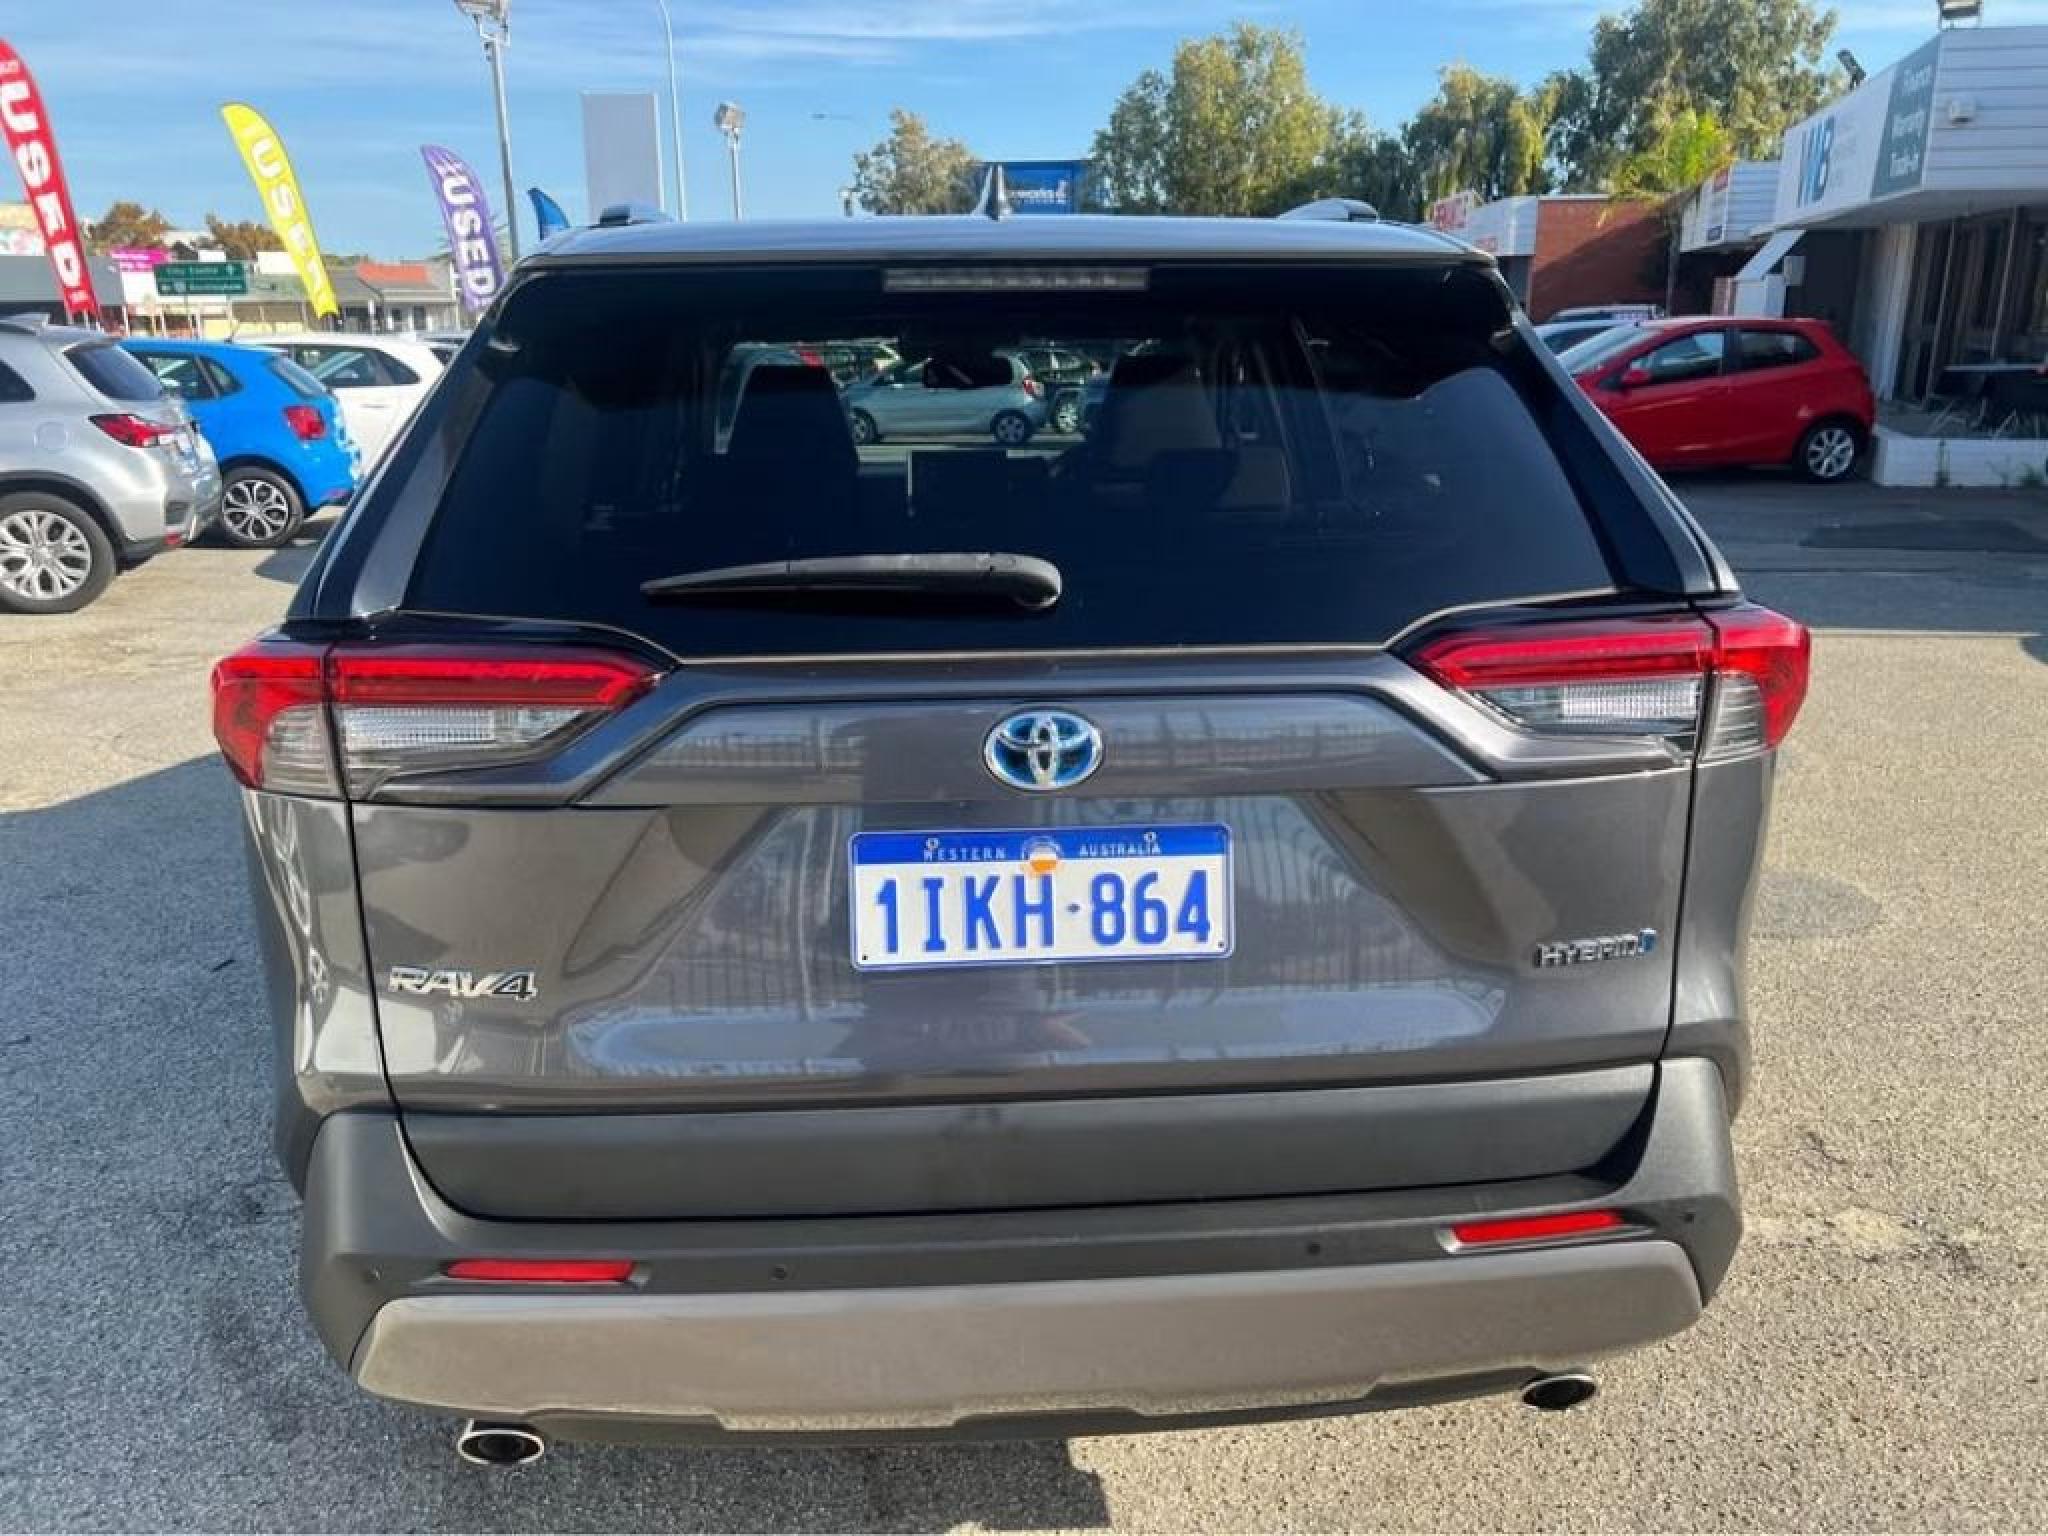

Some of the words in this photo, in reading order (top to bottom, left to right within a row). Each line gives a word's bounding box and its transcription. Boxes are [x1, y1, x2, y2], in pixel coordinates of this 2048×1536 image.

[443, 175, 495, 296] USED
[923, 846, 1007, 862] WESTERN
[1079, 841, 1162, 857] AUSTRALIA
[389, 965, 538, 1001] RAV4
